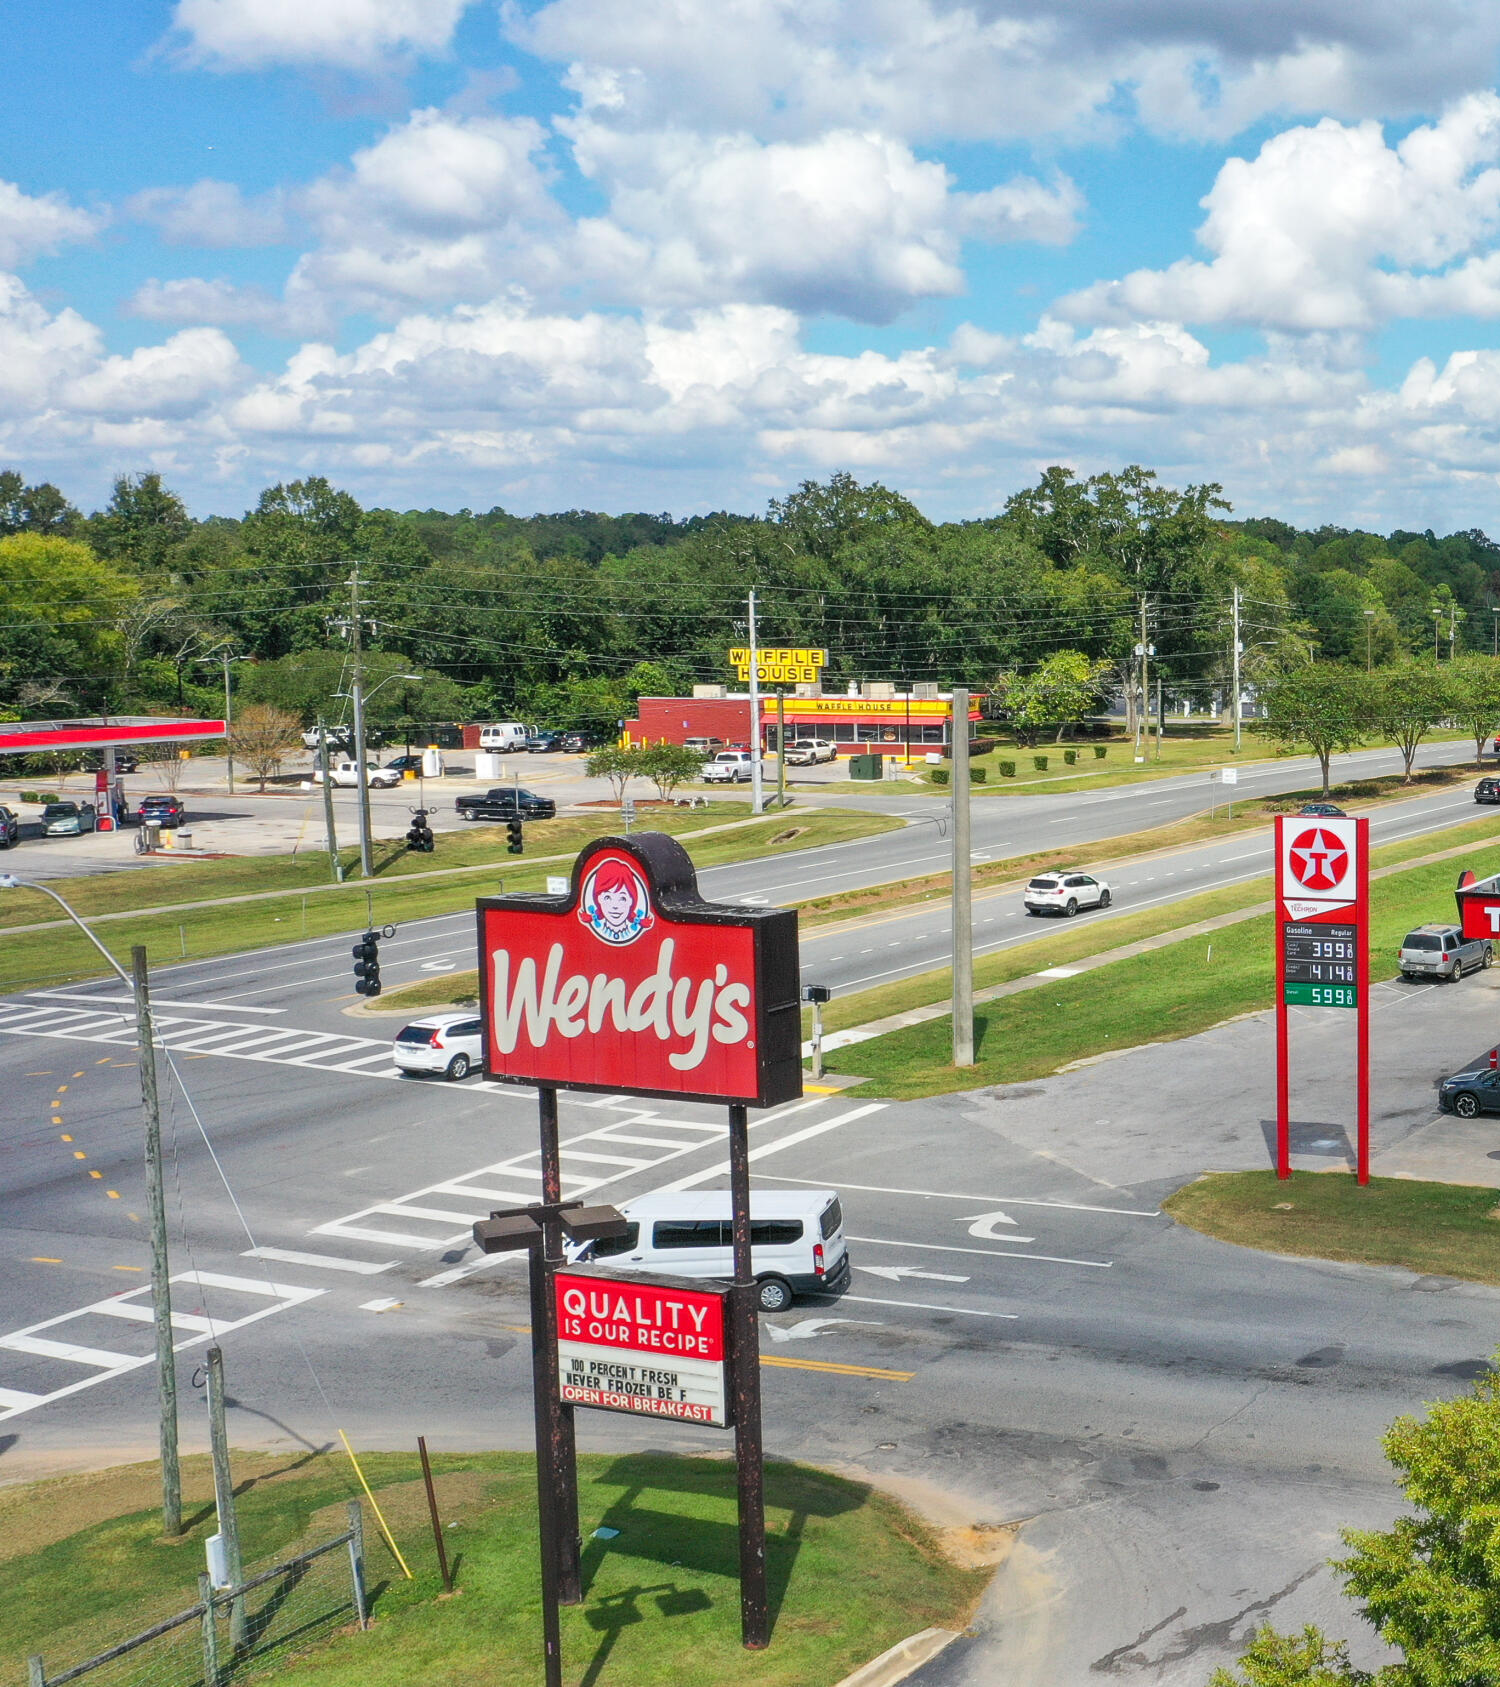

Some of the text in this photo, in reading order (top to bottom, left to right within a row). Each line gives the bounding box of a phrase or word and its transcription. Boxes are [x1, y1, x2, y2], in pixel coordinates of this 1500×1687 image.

[731, 651, 820, 664] WFFLE
[741, 667, 813, 680] HOUSE
[1286, 926, 1353, 937] Gasoline Regular
[492, 938, 750, 1070] Wendy's
[563, 1289, 708, 1332] QUALITY
[565, 1318, 709, 1353] IS OUR RECIPE
[571, 1358, 678, 1386] 100 PERCENT FRESH
[564, 1387, 600, 1403] OPEN
[602, 1393, 629, 1409] FOR
[566, 1372, 687, 1401] NEVER FROZEN BE F
